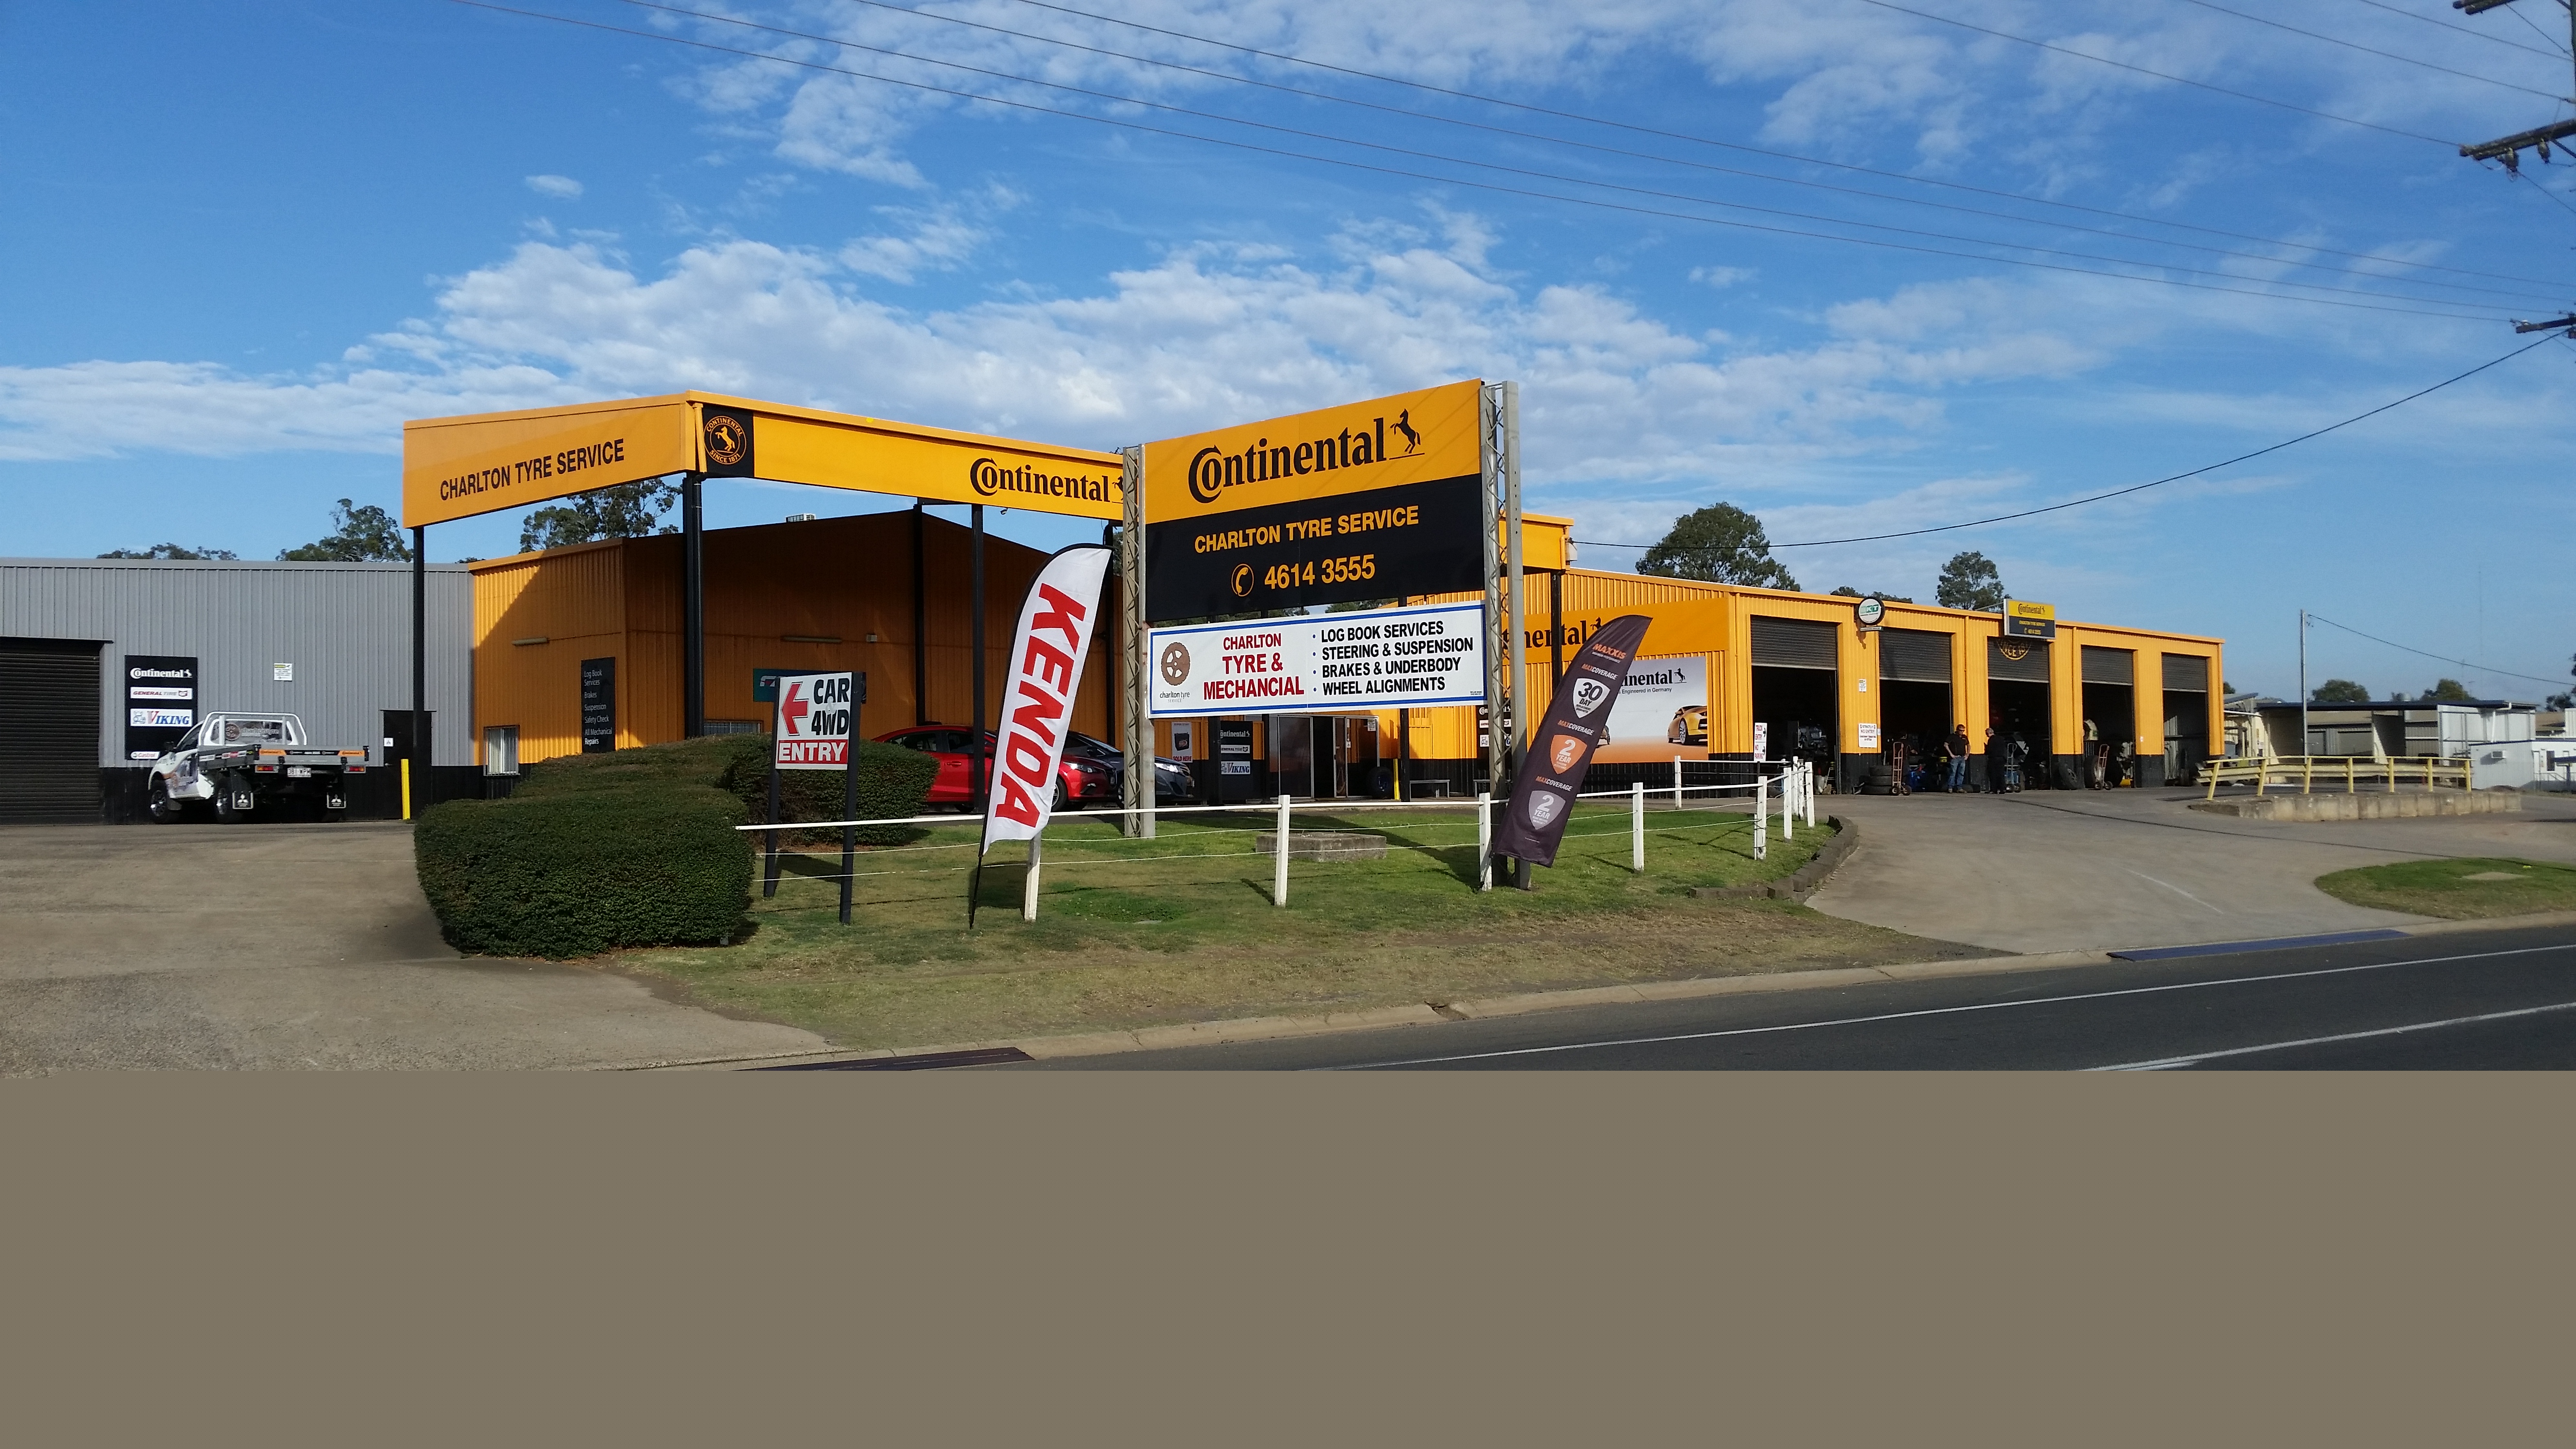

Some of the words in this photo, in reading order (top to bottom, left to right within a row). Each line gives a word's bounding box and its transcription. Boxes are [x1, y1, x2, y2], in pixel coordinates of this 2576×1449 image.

[707, 418, 742, 436] CONTINENTAL
[709, 450, 727, 463] SINCE
[728, 453, 741, 462] 1871
[1188, 418, 1387, 503] Continental
[441, 465, 511, 501] CHARLTON
[515, 455, 552, 483] TYRE
[557, 438, 624, 474] SERVICE
[970, 458, 1110, 502] Continental
[1194, 524, 1281, 553] CHARLTON
[1286, 517, 1333, 541] TYRE
[1337, 505, 1419, 533] SERVICE
[1264, 561, 1315, 590] 4614
[1321, 554, 1375, 584] 3555
[1861, 604, 1878, 613] KT
[2018, 604, 2042, 614] Continental
[1321, 629, 1345, 643] LOG
[1348, 625, 1381, 641] BOOK
[1384, 620, 1444, 638] SERVICES
[1223, 633, 1281, 650] CHARLTON
[1322, 644, 1379, 660] STEERING
[1383, 643, 1391, 656] &
[1394, 637, 1473, 655] SUSPENSION
[1592, 644, 1626, 659] MAXXIS
[1223, 654, 1267, 674] TYRE
[1272, 652, 1284, 671] &
[1322, 662, 1370, 678] BRAKES
[1373, 661, 1382, 675] &
[1385, 657, 1461, 675] UNDERBODY
[1581, 663, 1618, 680] MAXCOVERAGE
[130, 668, 183, 679] Continental
[814, 677, 850, 704] CAR
[1204, 676, 1304, 700] MECHANCIAL
[1322, 681, 1362, 696] WHEEL
[1366, 676, 1445, 693] ALIGNMENTS
[1578, 682, 1603, 701] 30
[825, 697, 836, 714] &
[995, 583, 1087, 828] KENDA
[147, 711, 190, 724] VIKING
[811, 709, 849, 736] 4WD
[1220, 730, 1246, 739] ontinental
[1558, 720, 1594, 736] MAXCOVERAGE
[585, 738, 599, 746] Repairs
[1559, 739, 1576, 757] 2
[778, 742, 846, 761] ENTRY
[1556, 754, 1571, 763] YEAR
[1227, 762, 1250, 773] VIKING
[1535, 776, 1573, 791] MAXCOVERAGE
[1537, 795, 1554, 812] 2
[1534, 809, 1550, 819] YEAR
